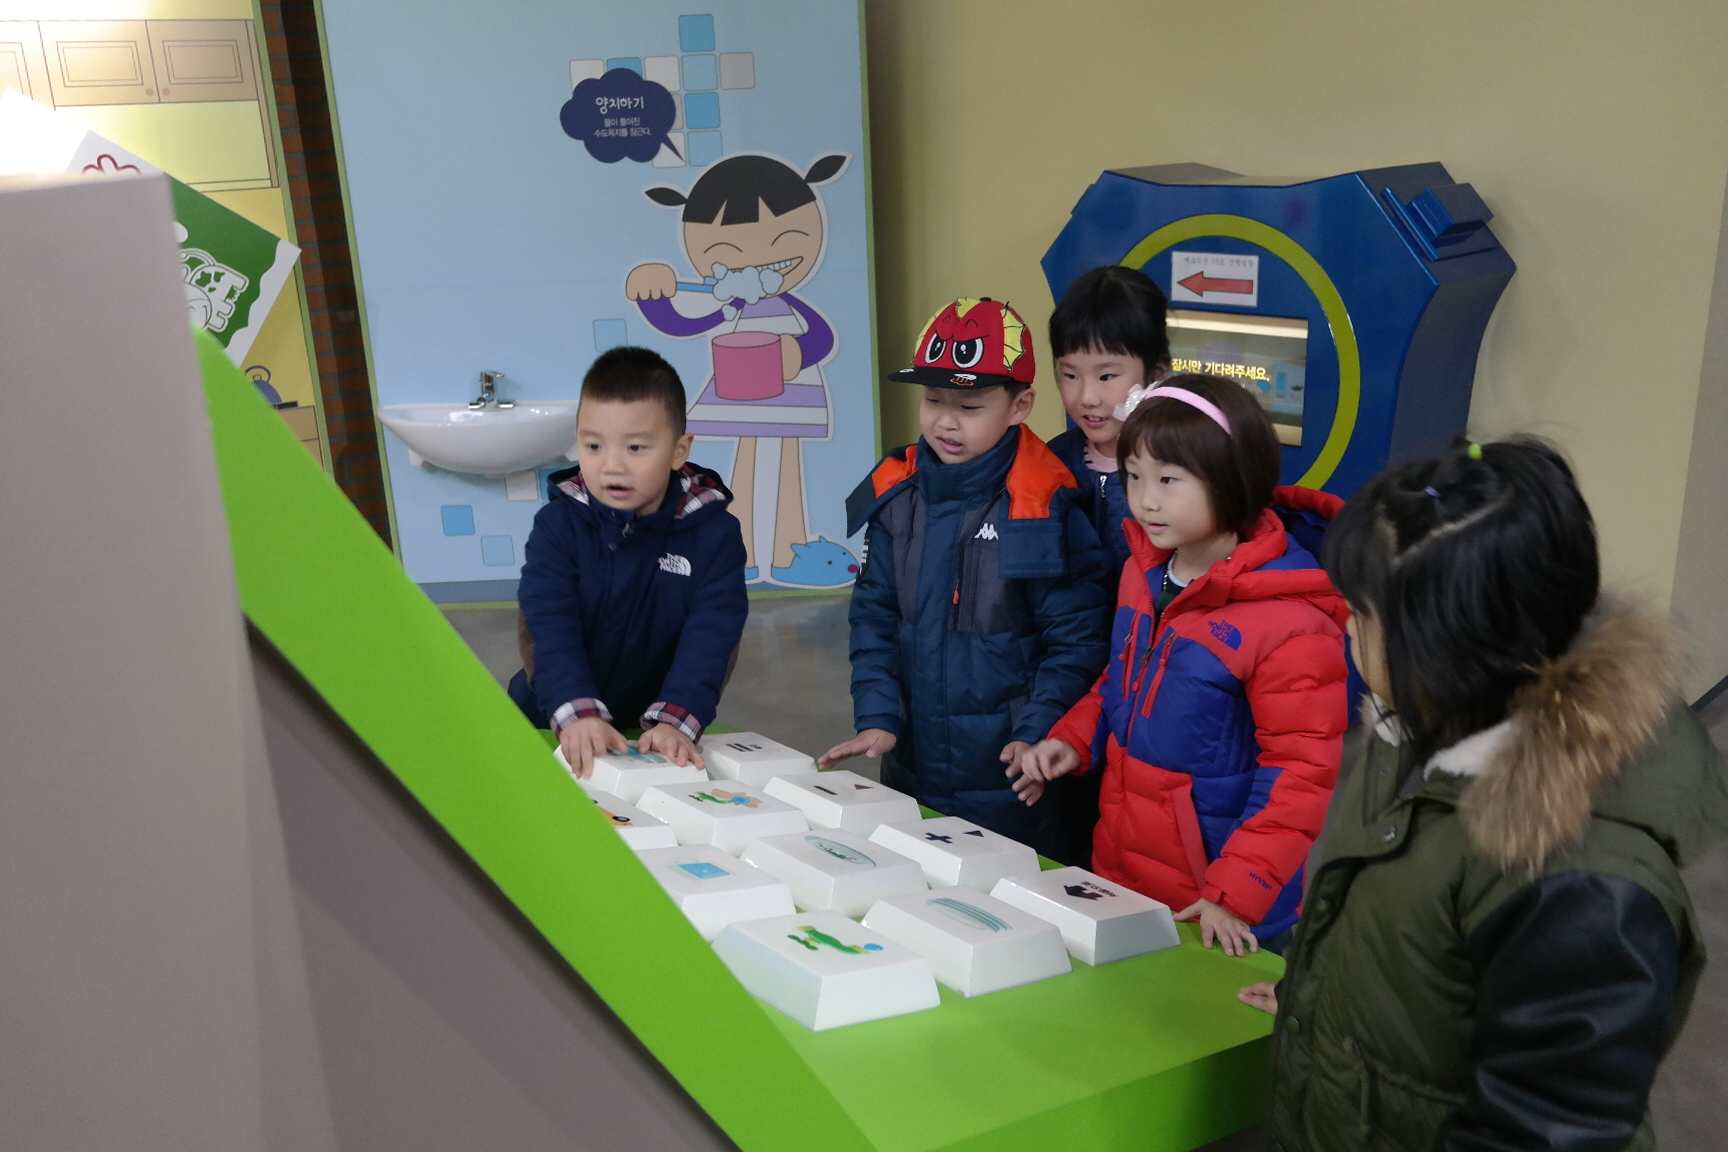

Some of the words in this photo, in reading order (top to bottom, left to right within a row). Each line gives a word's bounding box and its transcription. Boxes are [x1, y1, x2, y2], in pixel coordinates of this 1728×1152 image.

[595, 96, 645, 115] 양치하기
[1171, 358, 1202, 374] 잠시만
[1204, 361, 1270, 382] 기다려주세요.
